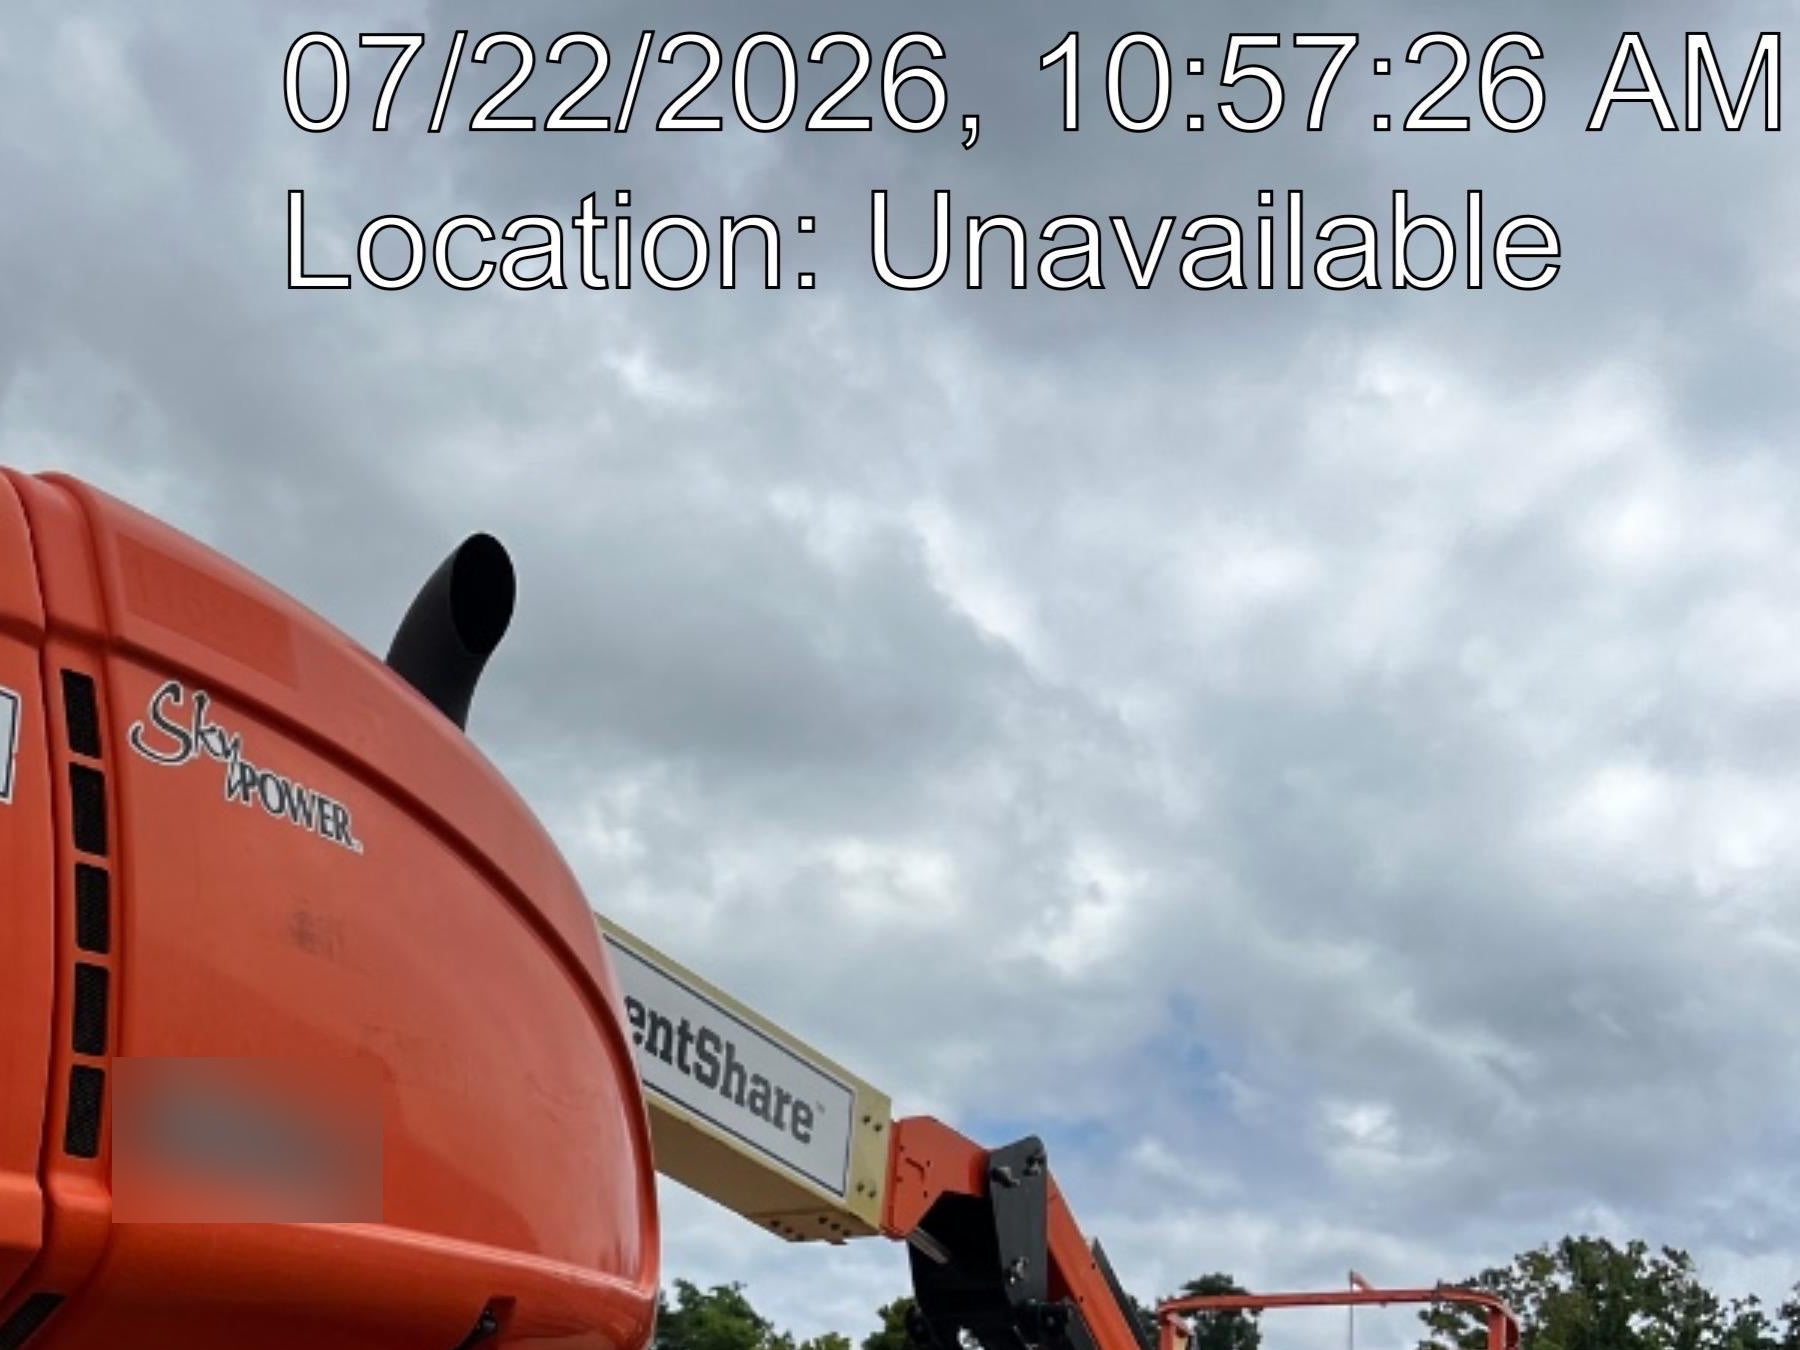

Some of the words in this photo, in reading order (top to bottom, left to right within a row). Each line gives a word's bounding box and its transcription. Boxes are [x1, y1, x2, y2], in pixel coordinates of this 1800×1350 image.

[129, 680, 242, 801] Sky
[236, 761, 357, 850] POWER
[623, 994, 814, 1144] entShare
